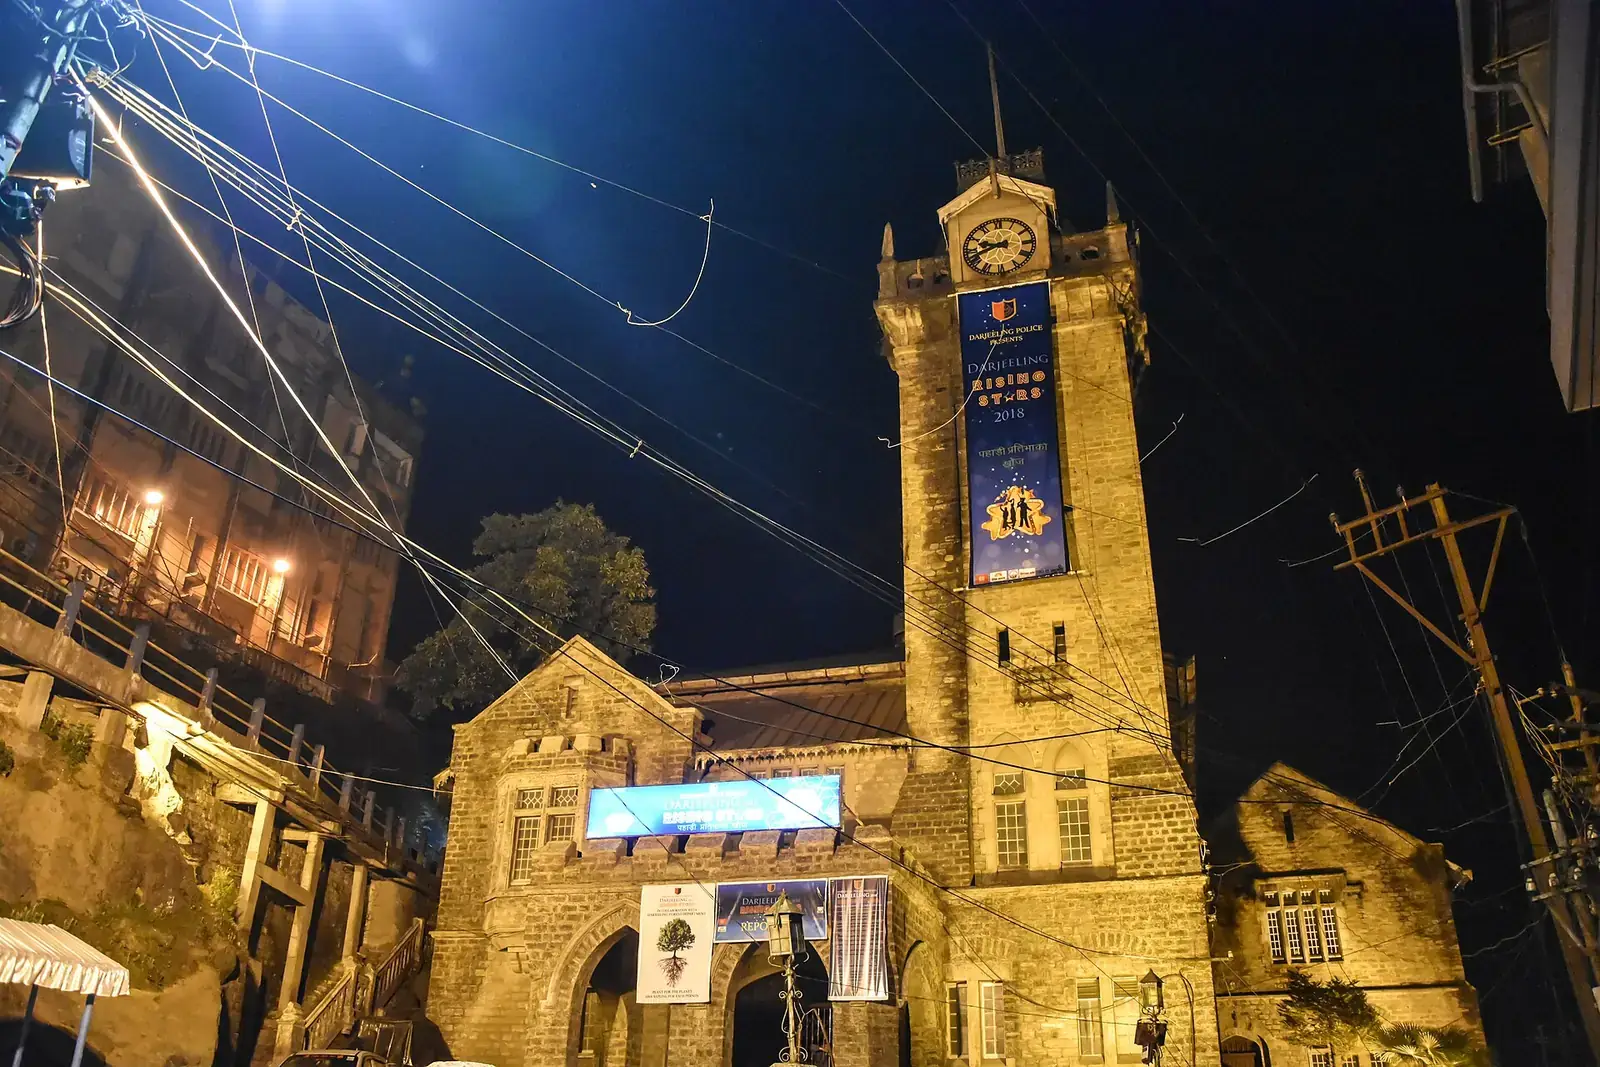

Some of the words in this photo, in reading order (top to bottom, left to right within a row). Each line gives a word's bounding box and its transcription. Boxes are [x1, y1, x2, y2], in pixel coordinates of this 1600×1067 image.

[969, 328, 1014, 340] DARJEELING
[1016, 324, 1043, 334] POLICE
[990, 335, 1023, 346] PRESENTS
[968, 354, 1049, 374] DARJEELING
[972, 370, 1045, 391] RISING
[994, 408, 1025, 423] 2018
[741, 921, 768, 932] REPO
